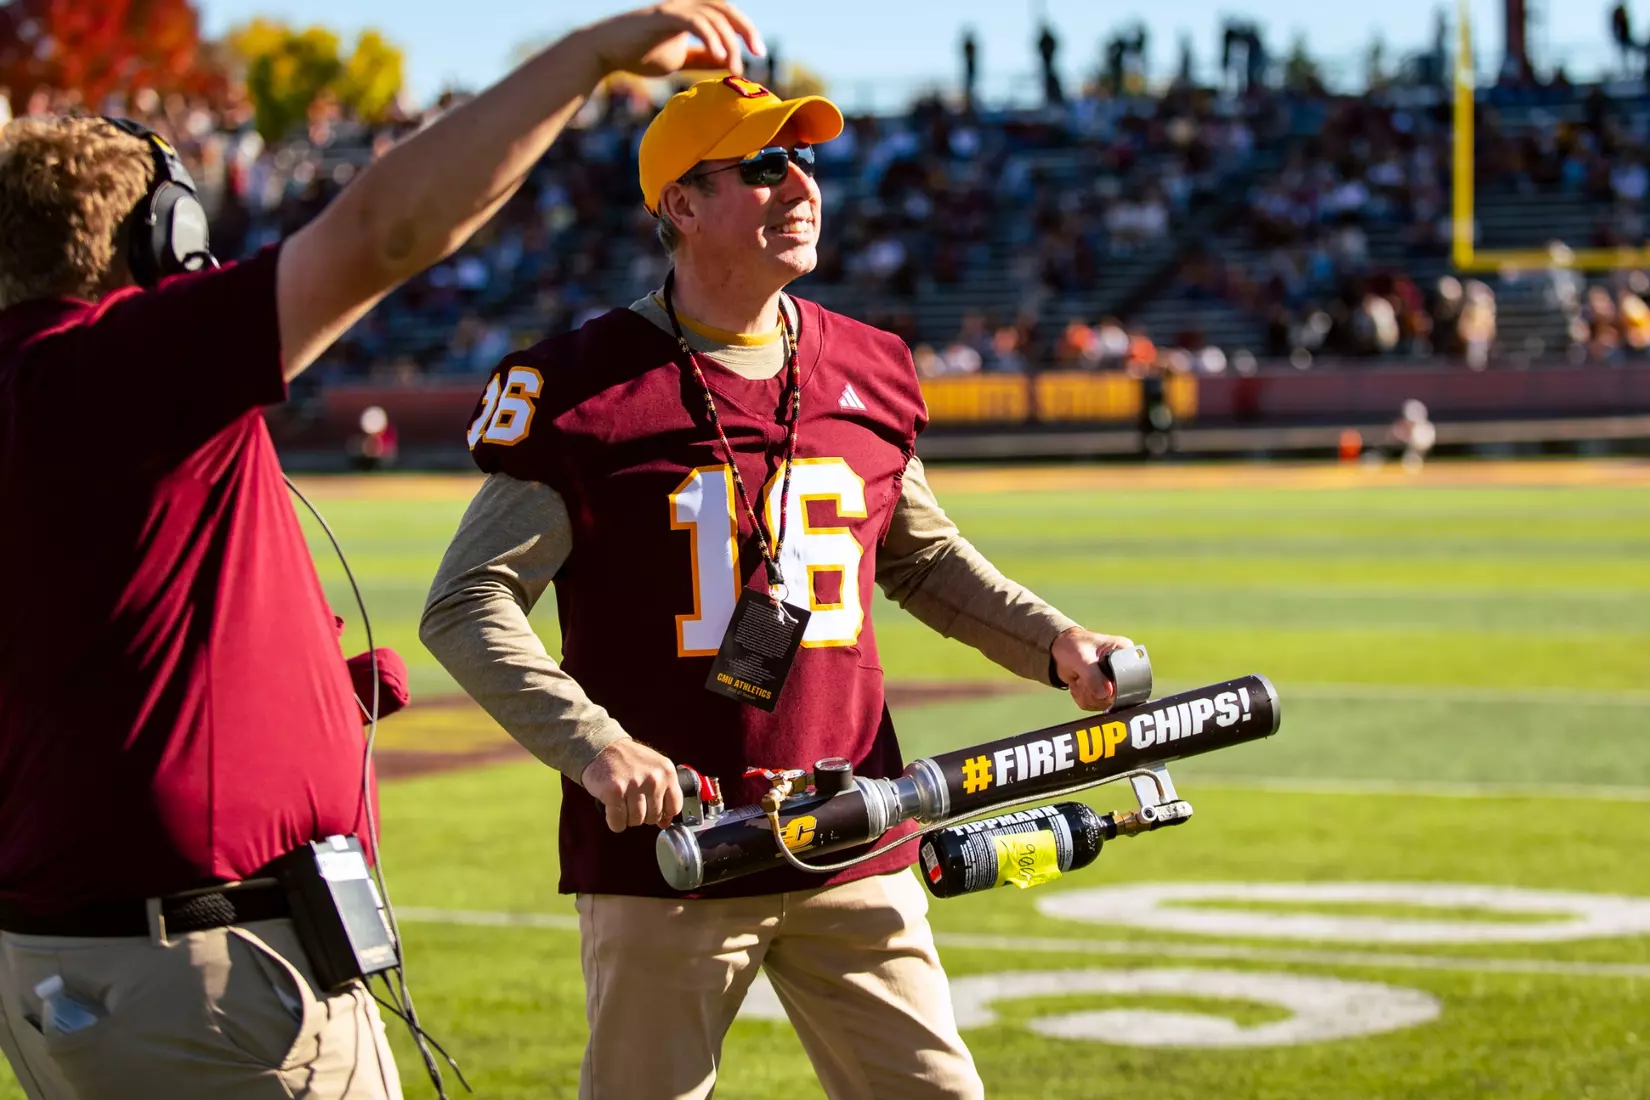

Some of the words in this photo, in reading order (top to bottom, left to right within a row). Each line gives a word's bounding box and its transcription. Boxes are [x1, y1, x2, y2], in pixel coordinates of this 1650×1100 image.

[467, 366, 544, 451] 16
[668, 457, 868, 657] 16
[717, 672, 733, 685] CMU
[734, 680, 772, 700] ATHLETICS
[946, 805, 1060, 836] TIPPMANN
